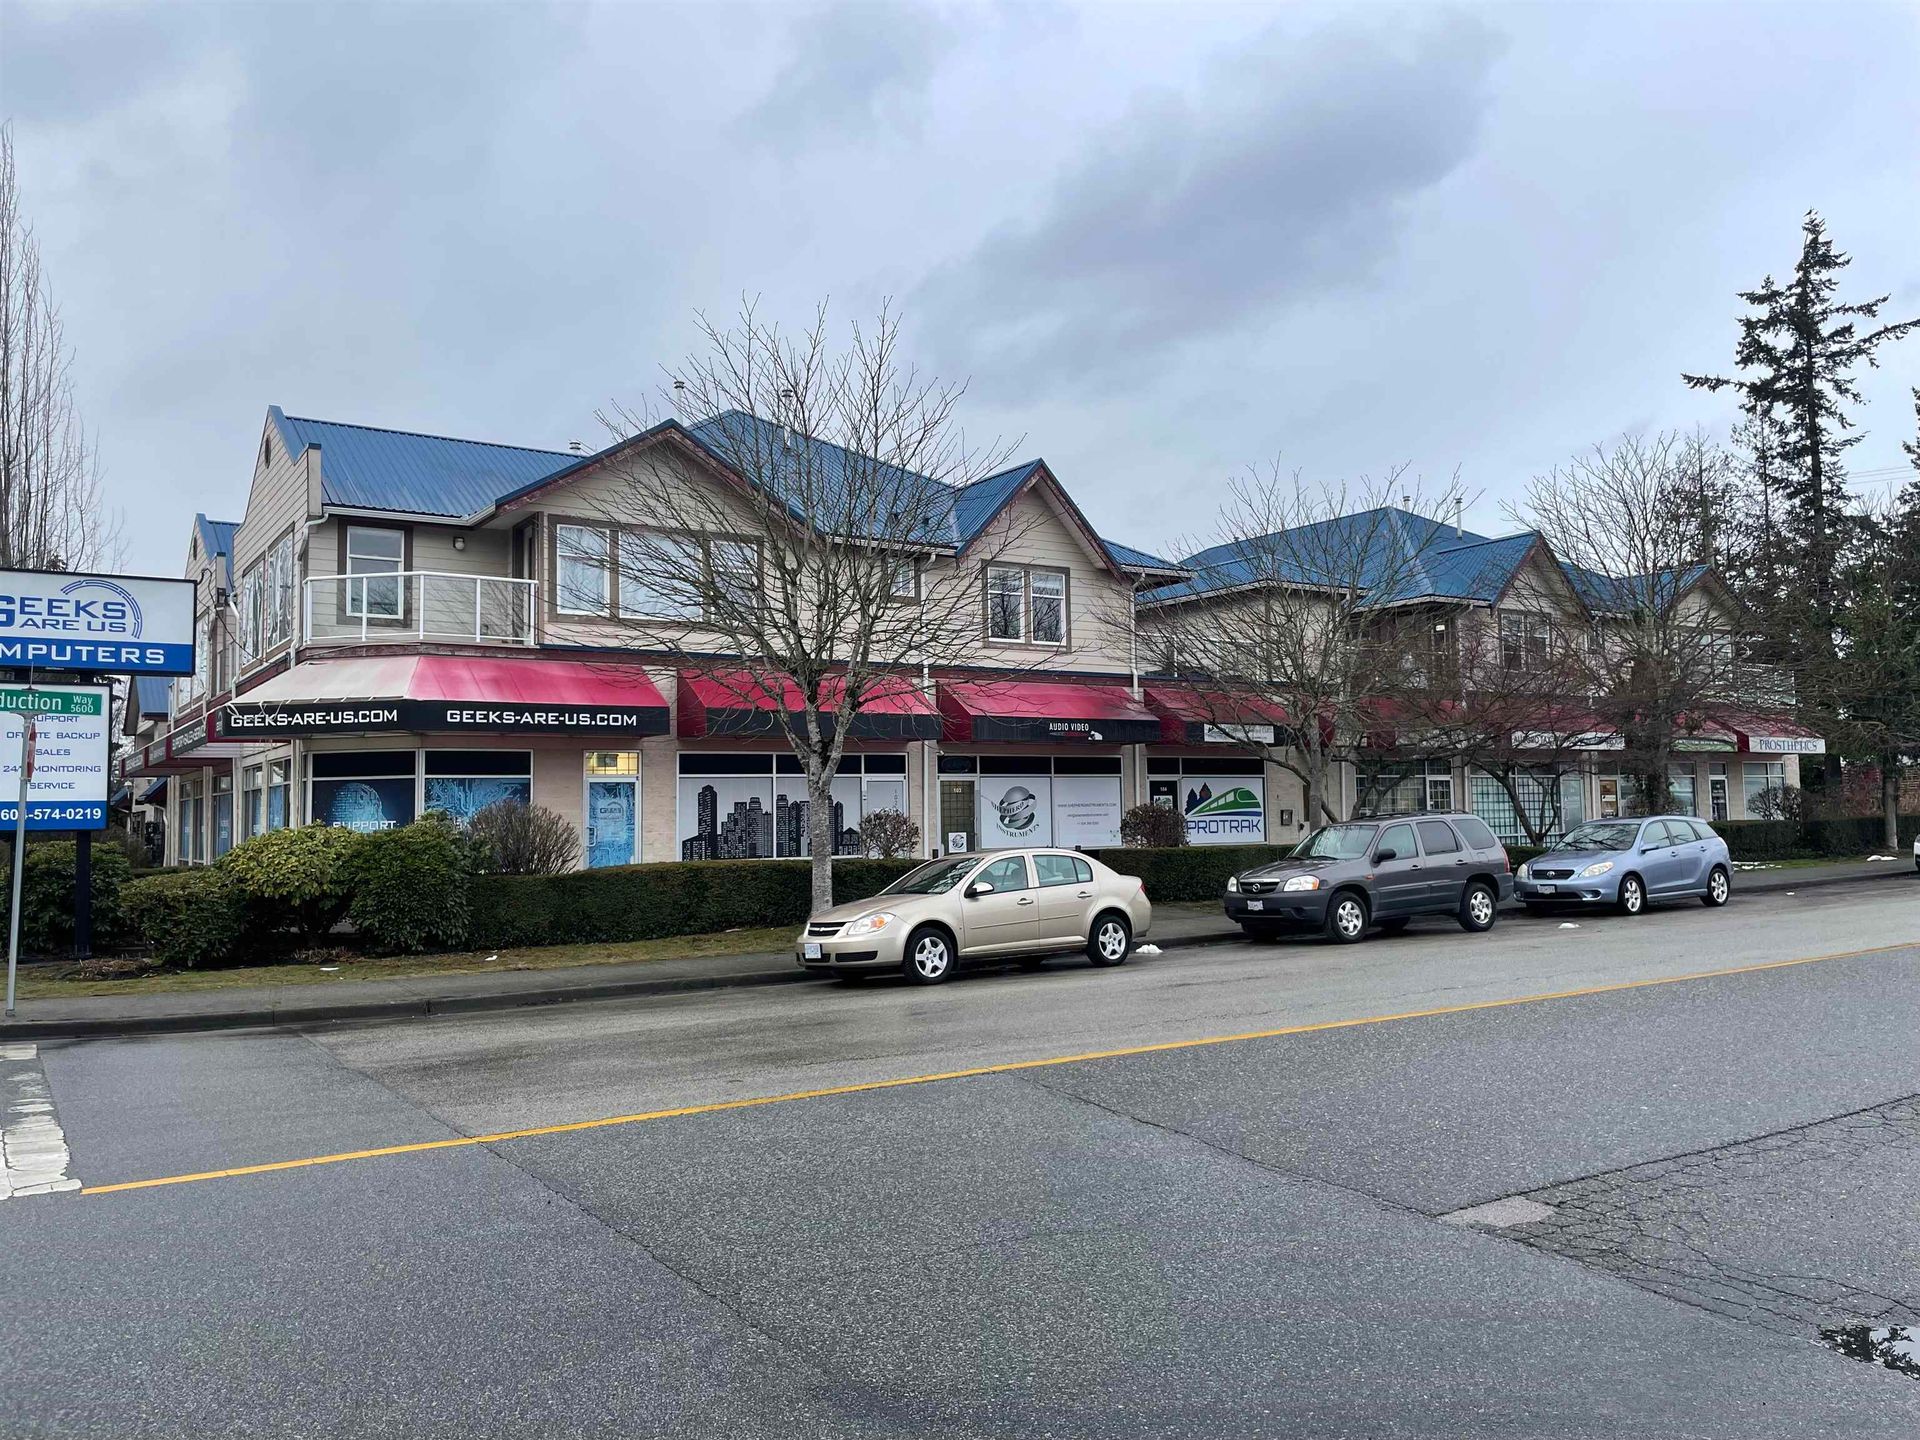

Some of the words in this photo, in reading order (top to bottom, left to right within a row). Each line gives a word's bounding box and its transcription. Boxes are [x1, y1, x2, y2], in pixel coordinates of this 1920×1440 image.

[19, 618, 79, 630] ARE
[87, 621, 126, 632] US
[0, 643, 164, 664] MPUTERS
[73, 695, 93, 706] Way
[70, 704, 94, 713] 5600
[34, 715, 80, 723] UPPORT
[231, 710, 398, 727] GEEKS-ARE-US.COM
[447, 710, 637, 726] GEEKS-ARE-US.COM
[1049, 723, 1069, 731] AUDIO
[1071, 723, 1089, 731] VIDEO
[6, 731, 50, 739] OFTE
[56, 732, 101, 740] BACKUP
[36, 748, 71, 756] SALES
[3, 765, 22, 773] 24/
[34, 765, 102, 773] MONITORING
[29, 782, 76, 790] SERVICE
[0, 808, 102, 820] 60-574-0219
[1186, 819, 1262, 834] PROTRAK
